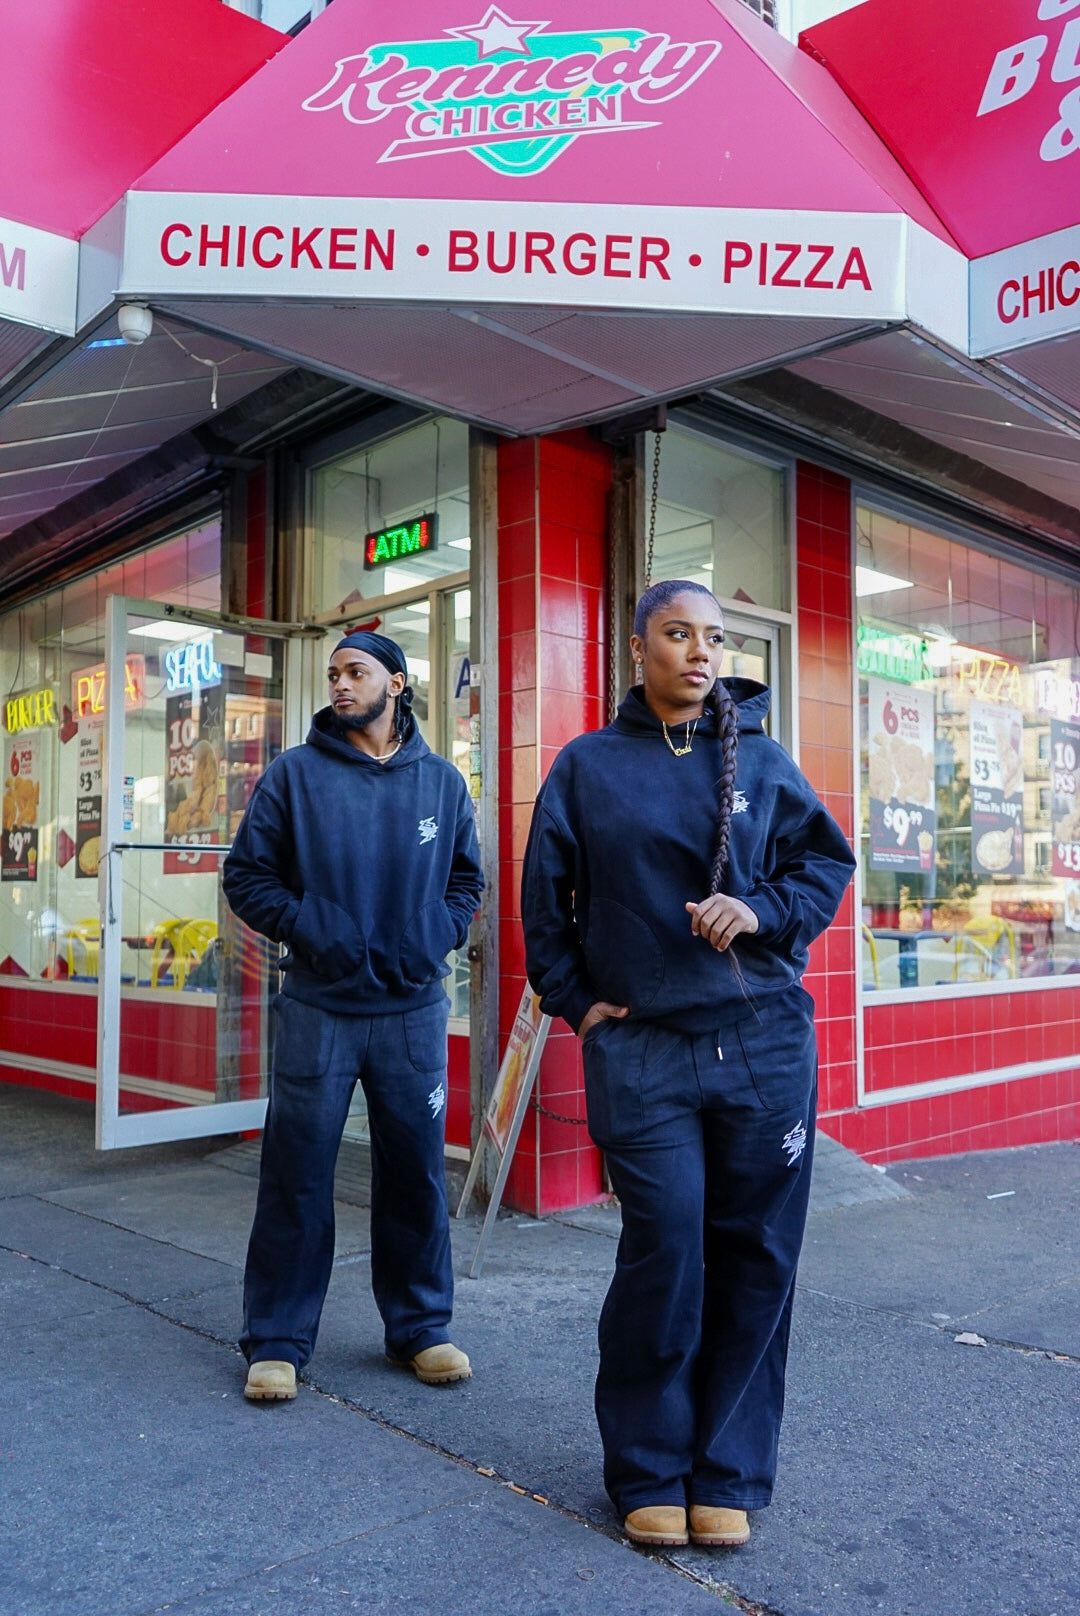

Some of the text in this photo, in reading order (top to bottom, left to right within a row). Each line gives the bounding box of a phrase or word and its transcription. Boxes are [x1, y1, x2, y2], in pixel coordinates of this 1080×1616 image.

[302, 33, 722, 124] Kennedy
[408, 95, 619, 138] CHICKEN
[160, 223, 873, 291] CHICKEN BURGER PIZZA
[998, 260, 1080, 324] CHIC
[373, 523, 421, 562] ATM
[959, 655, 1022, 706] PIZZA
[170, 718, 195, 750] 10
[882, 700, 899, 735] 6
[900, 706, 920, 723] PCS
[10, 751, 20, 777] 6
[170, 752, 194, 777] PCS
[1054, 741, 1076, 771] 10
[1054, 772, 1076, 794] PCS
